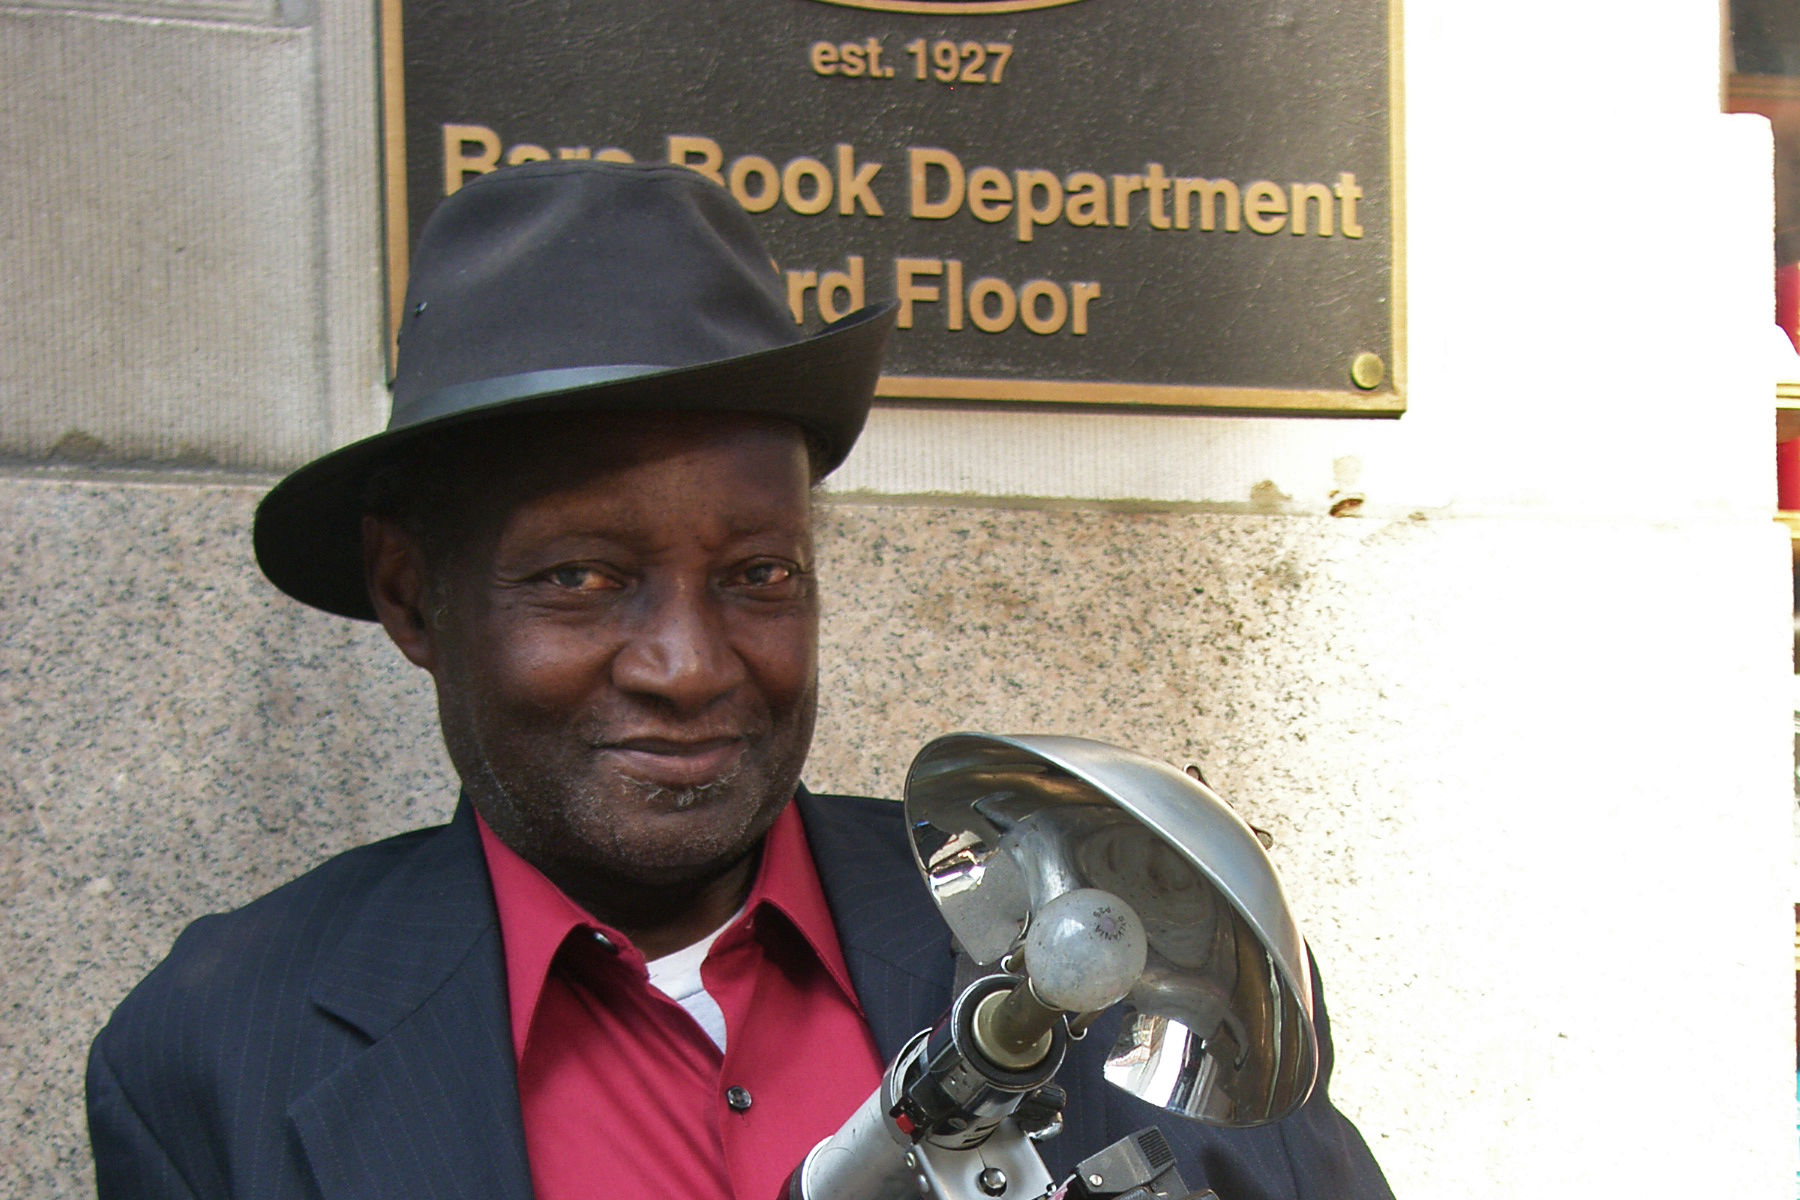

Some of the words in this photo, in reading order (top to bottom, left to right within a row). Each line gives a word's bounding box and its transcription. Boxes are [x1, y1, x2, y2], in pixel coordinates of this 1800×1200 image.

[811, 37, 895, 79] est.
[905, 38, 1014, 84] 1927
[907, 147, 1364, 242] Department
[770, 256, 865, 325] rd
[895, 258, 1100, 335] Floor
